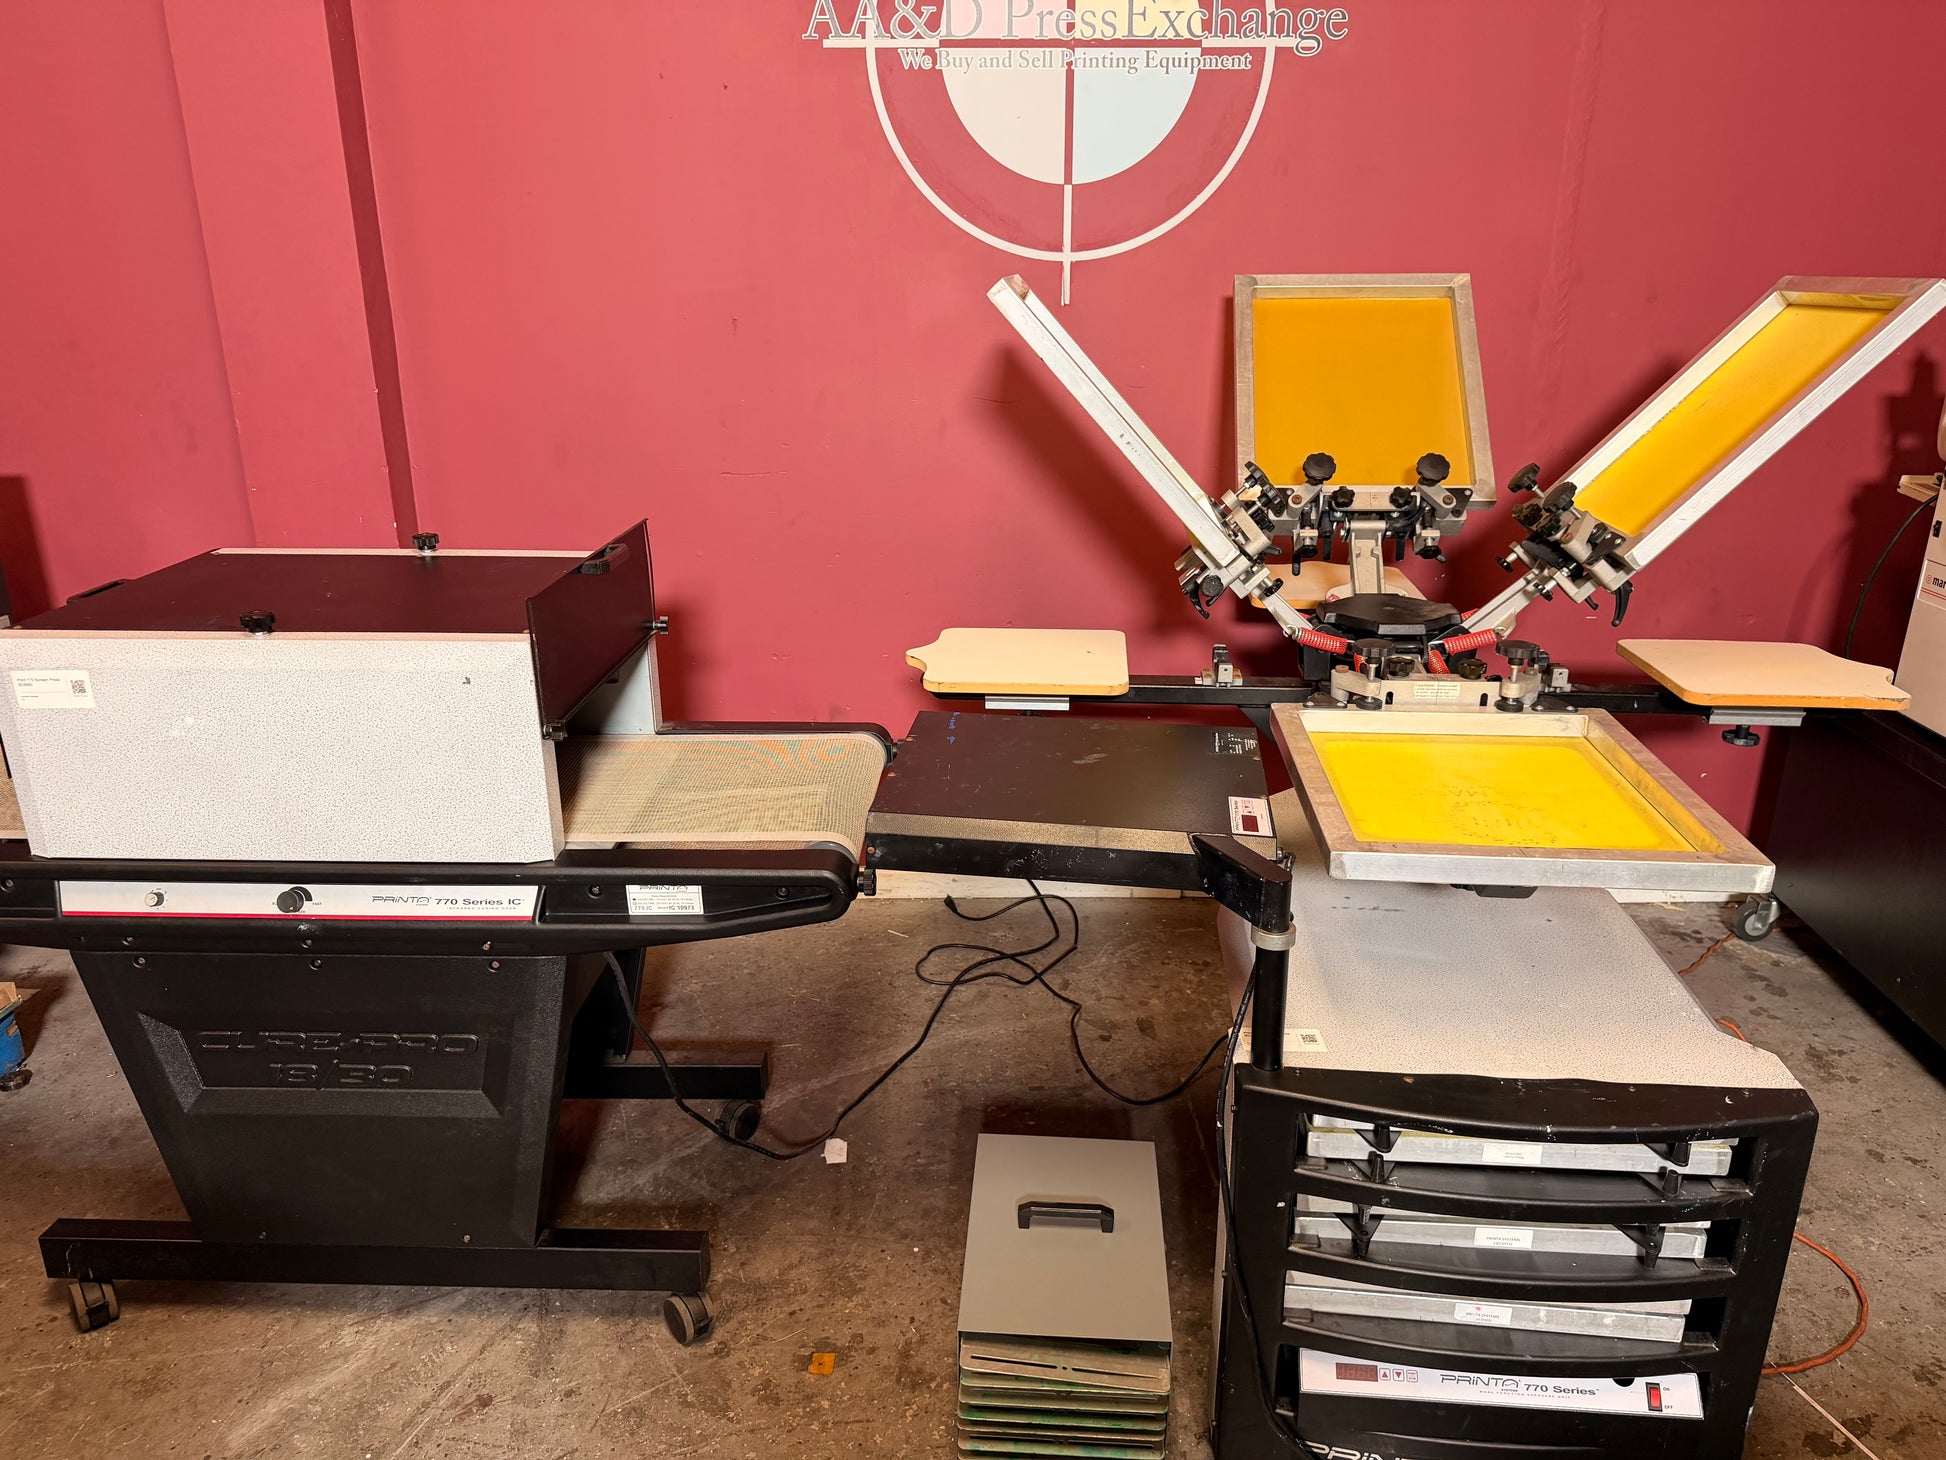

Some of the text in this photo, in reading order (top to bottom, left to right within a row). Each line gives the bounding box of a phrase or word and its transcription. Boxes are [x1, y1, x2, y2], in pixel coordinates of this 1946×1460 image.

[802, 0, 1348, 56] AA&D PressExchange
[898, 48, 1252, 75] We Buy and Sell Printing Equipment
[1524, 1384, 1548, 1392] 770
[1553, 1385, 1596, 1396] Series
